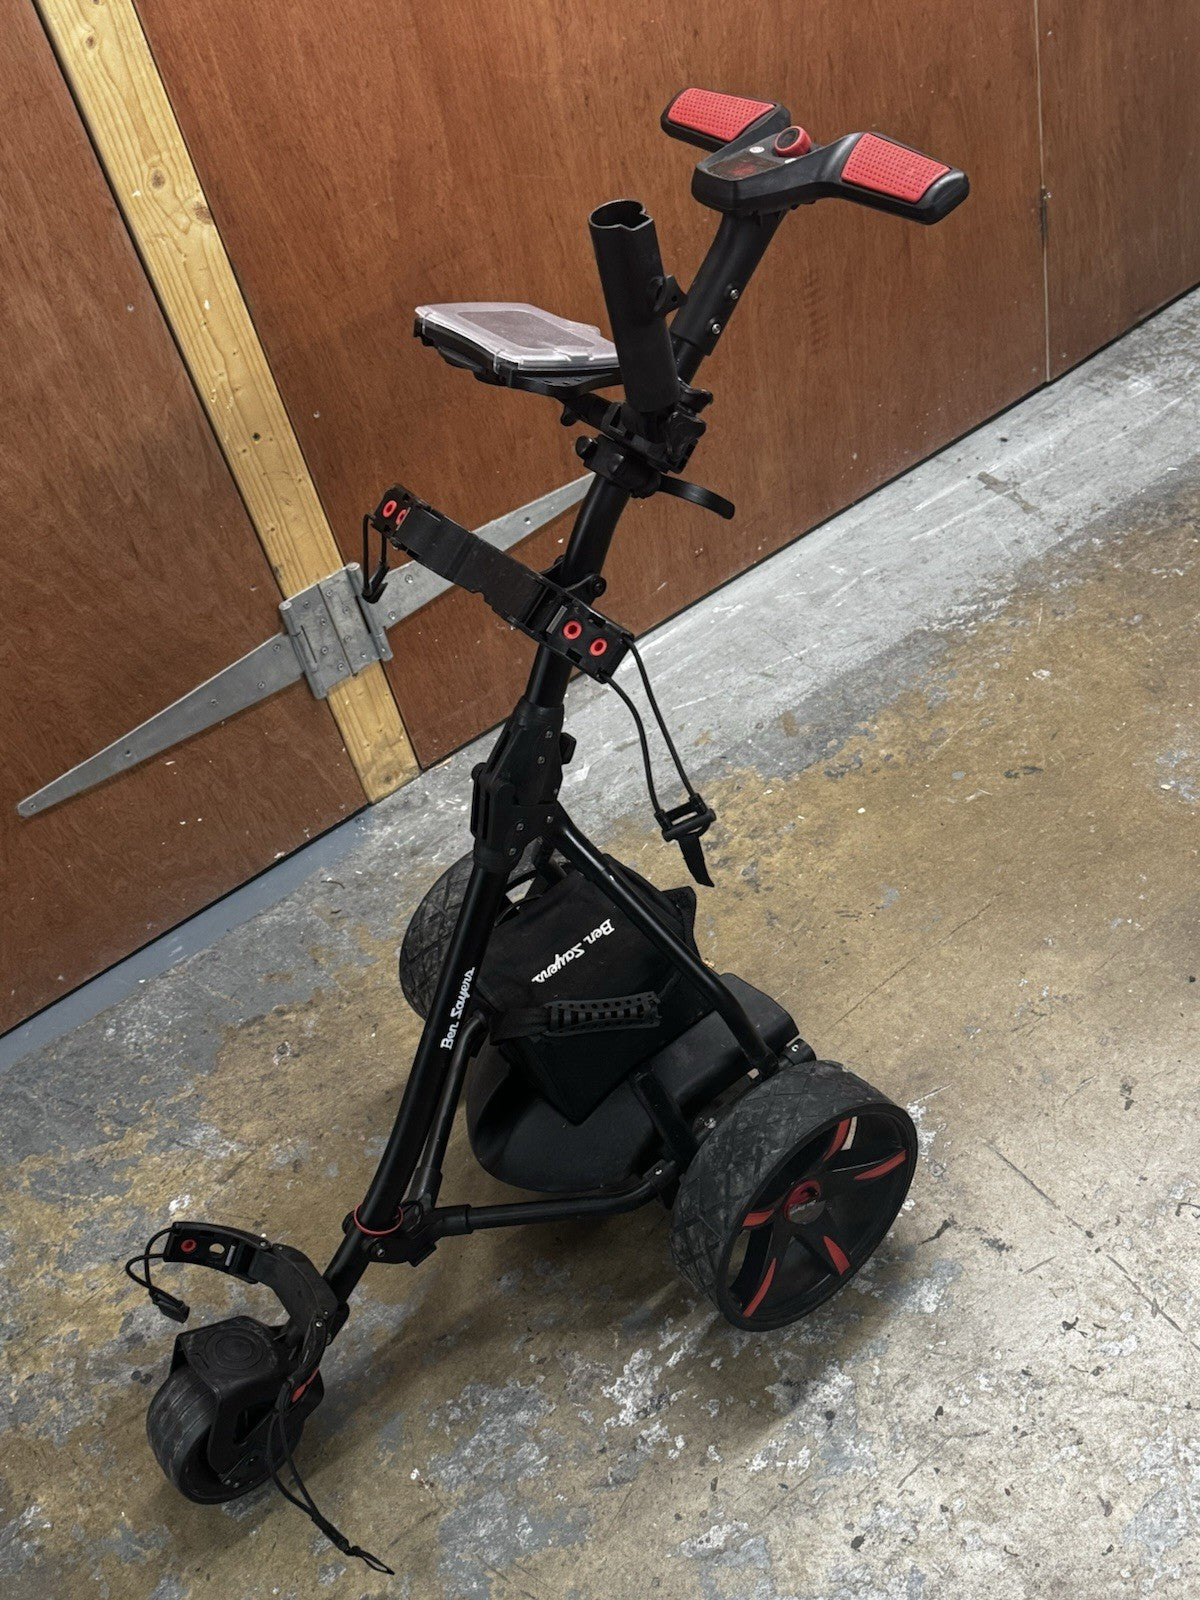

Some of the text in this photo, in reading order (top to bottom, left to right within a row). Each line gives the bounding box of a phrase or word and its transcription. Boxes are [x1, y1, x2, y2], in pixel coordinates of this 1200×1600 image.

[531, 918, 615, 983] Ben Sayers
[440, 966, 475, 1050] Ben Sayers
